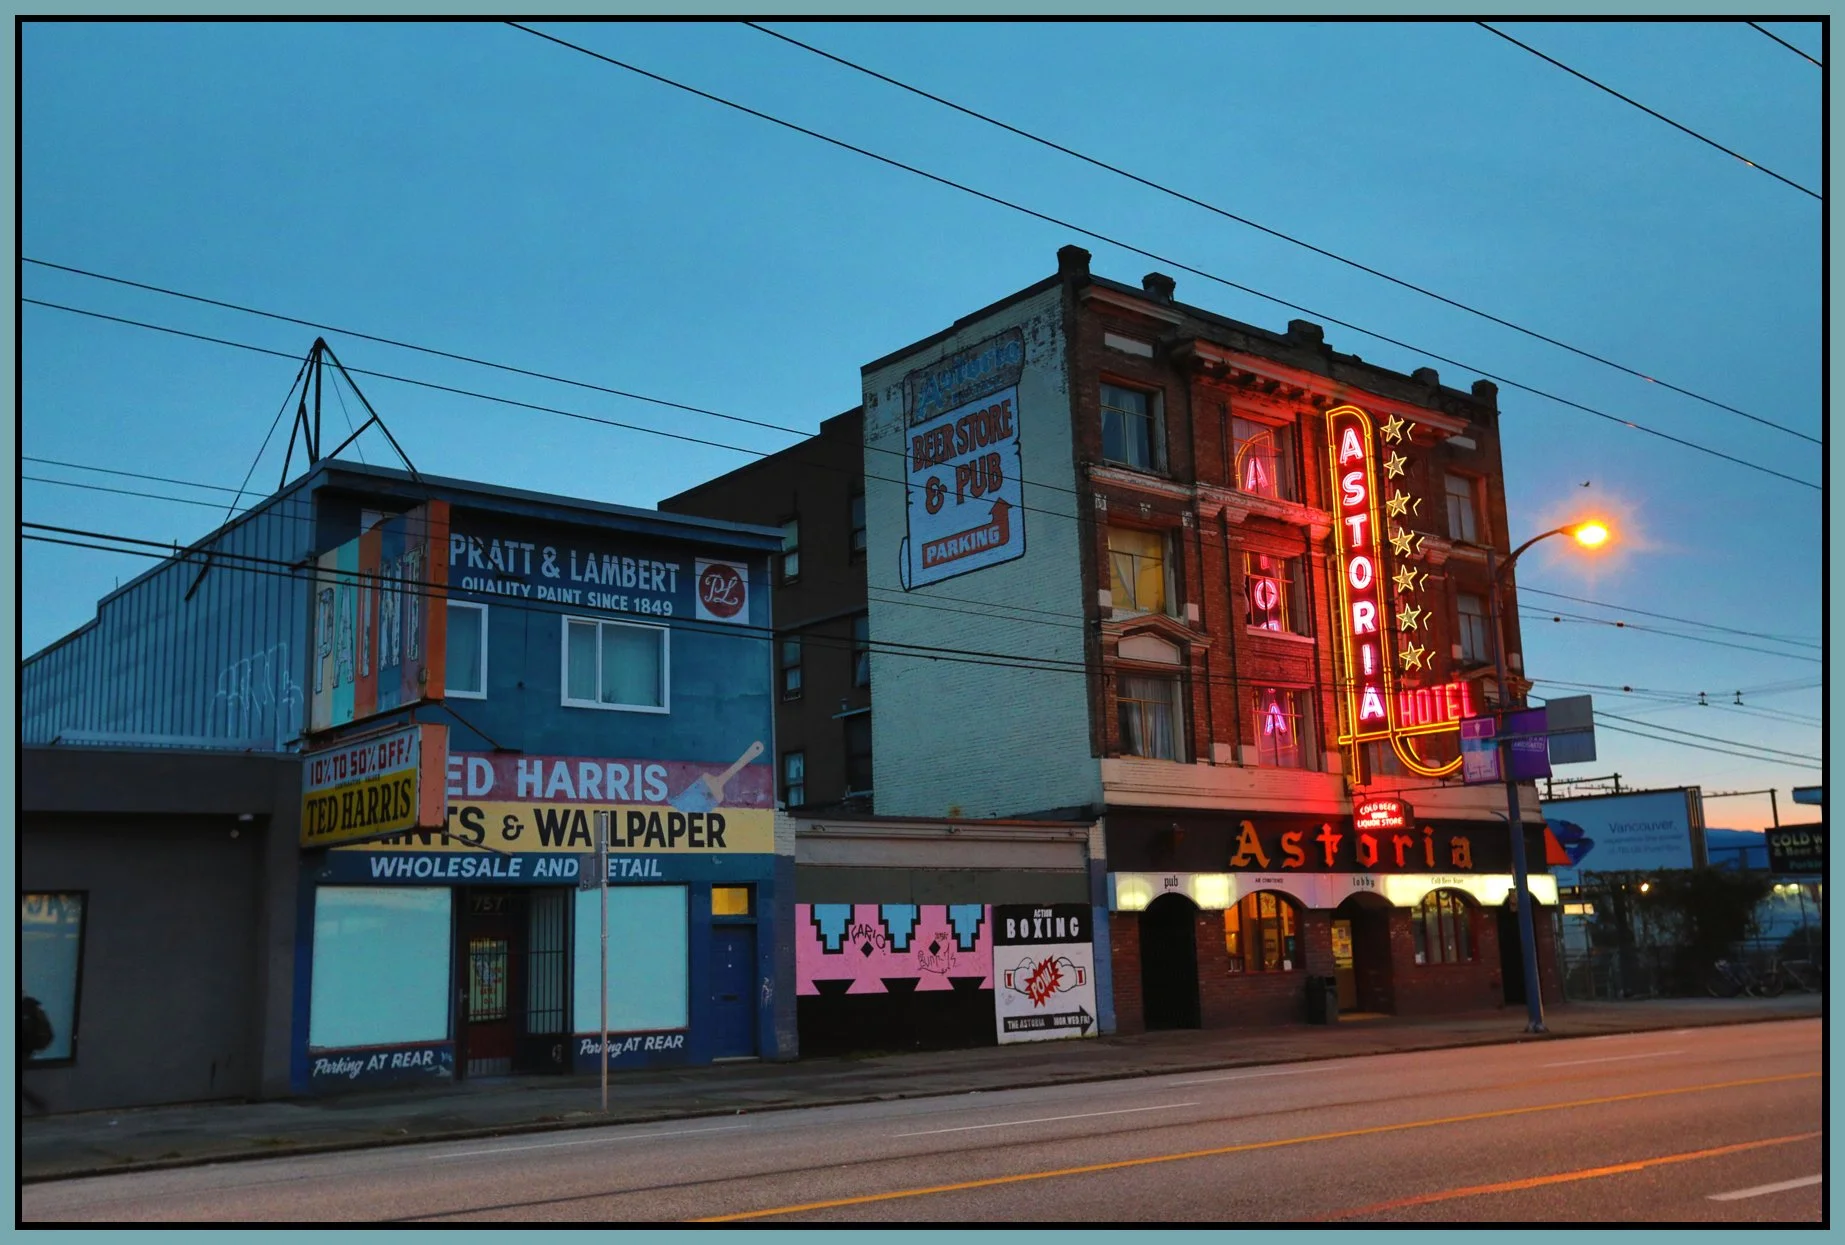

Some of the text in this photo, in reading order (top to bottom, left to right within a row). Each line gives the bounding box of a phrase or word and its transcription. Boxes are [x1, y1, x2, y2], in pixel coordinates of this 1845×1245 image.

[912, 399, 1014, 473] BEER STORE
[925, 452, 1004, 515] & PUB
[449, 533, 680, 593] PRATT & LAMBERT
[926, 524, 1001, 564] PARKING
[1338, 426, 1385, 721] ASTORIA
[461, 576, 673, 617] QUALITY PAINT SINCE 1849
[314, 543, 428, 696] PAINT
[1399, 681, 1478, 729] HOTEL
[310, 757, 332, 787] 10%
[333, 753, 347, 781] TO
[350, 745, 376, 777] 50%
[378, 734, 414, 770] OFF!
[447, 755, 669, 803] ED HARRIS
[306, 795, 339, 837] TED
[340, 778, 412, 830] HARRIS
[502, 814, 524, 841] &
[533, 808, 727, 849] WALPAPER
[1229, 819, 1474, 869] Astoria
[1771, 831, 1811, 848] COLD
[369, 856, 663, 878] WHOLESALE AND ETAIL
[1164, 874, 1179, 889] pub
[1006, 916, 1080, 939] BOXING
[1033, 908, 1053, 918] ACTION
[1030, 961, 1055, 1000] POW!
[1008, 1019, 1019, 1030] THE
[312, 1050, 435, 1080] Parking AT REAR
[579, 1034, 685, 1059] Paring AT REAR
